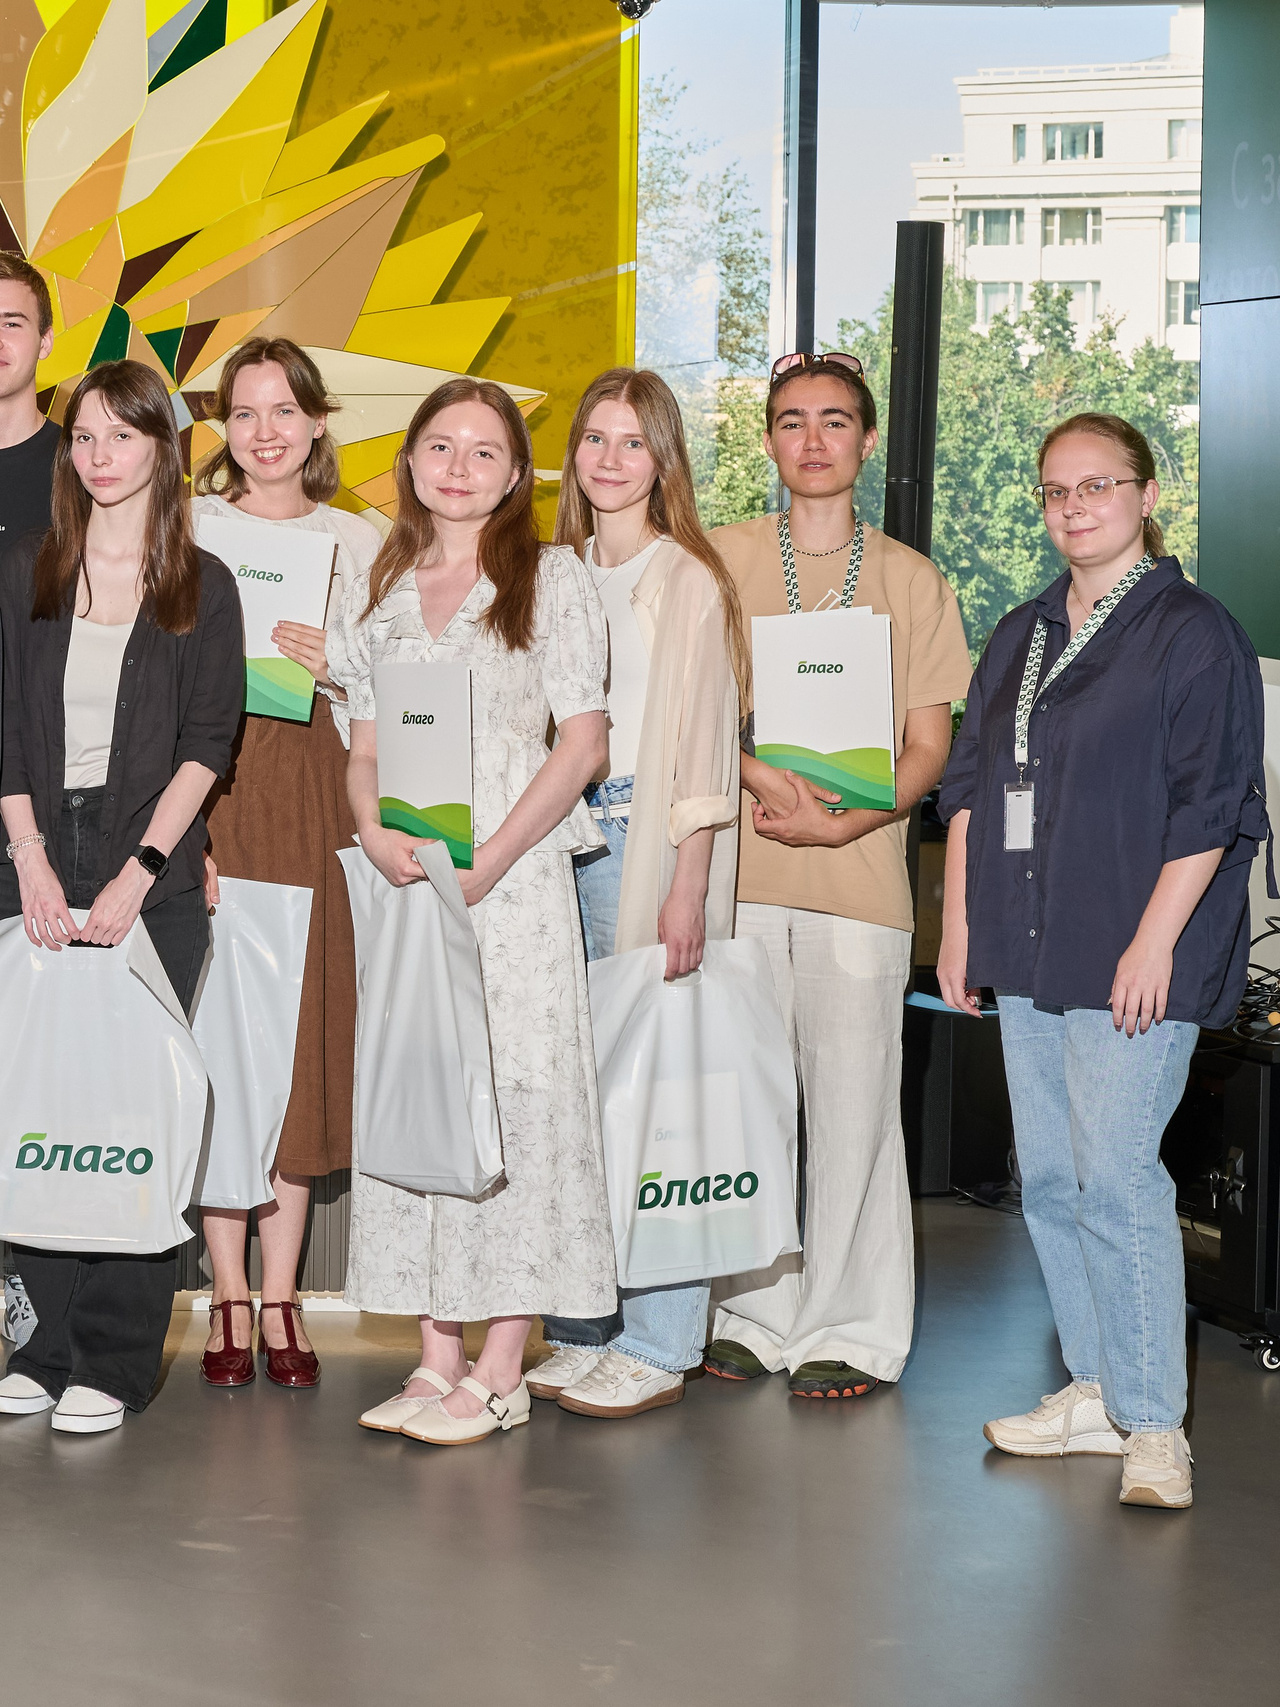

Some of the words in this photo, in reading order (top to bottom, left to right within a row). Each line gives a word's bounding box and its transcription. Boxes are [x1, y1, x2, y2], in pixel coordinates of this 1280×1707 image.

[236, 564, 284, 583] благо
[796, 660, 844, 674] благо
[402, 710, 435, 725] благо
[14, 1132, 154, 1175] благо
[637, 1170, 759, 1211] благо
